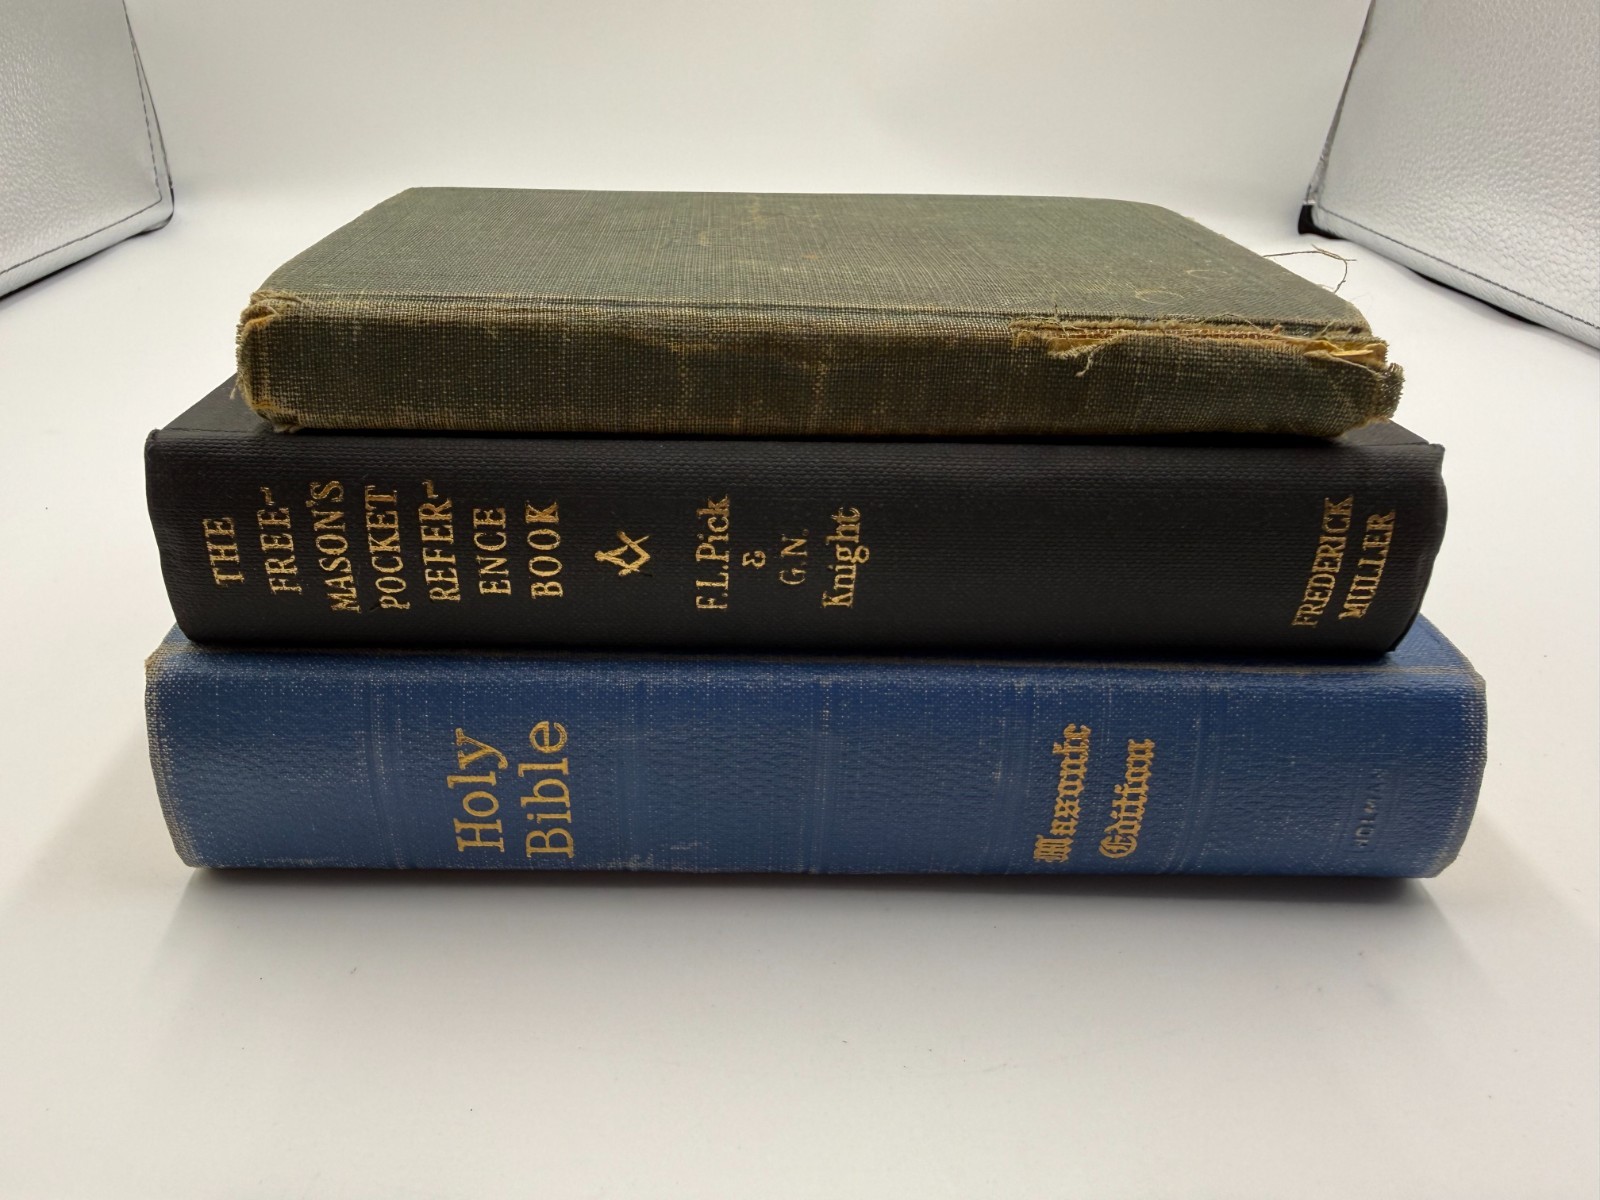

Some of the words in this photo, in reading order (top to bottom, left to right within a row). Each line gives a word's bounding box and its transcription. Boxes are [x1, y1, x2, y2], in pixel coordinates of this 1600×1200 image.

[203, 517, 245, 588] THE
[258, 486, 302, 595] FREE-
[306, 480, 361, 614] MASON'S
[364, 485, 411, 610] POCKET
[418, 479, 461, 603] REFER-
[473, 508, 511, 596] ENCE
[525, 501, 563, 600] BOOK
[741, 550, 766, 569] &
[820, 506, 870, 609] Knight
[1291, 495, 1354, 627] FREDERICK
[1338, 509, 1396, 619] MULLER
[447, 727, 509, 852] Holy
[517, 720, 575, 859] Bible
[1032, 723, 1092, 863] Masonic
[1098, 738, 1155, 859] Edition
